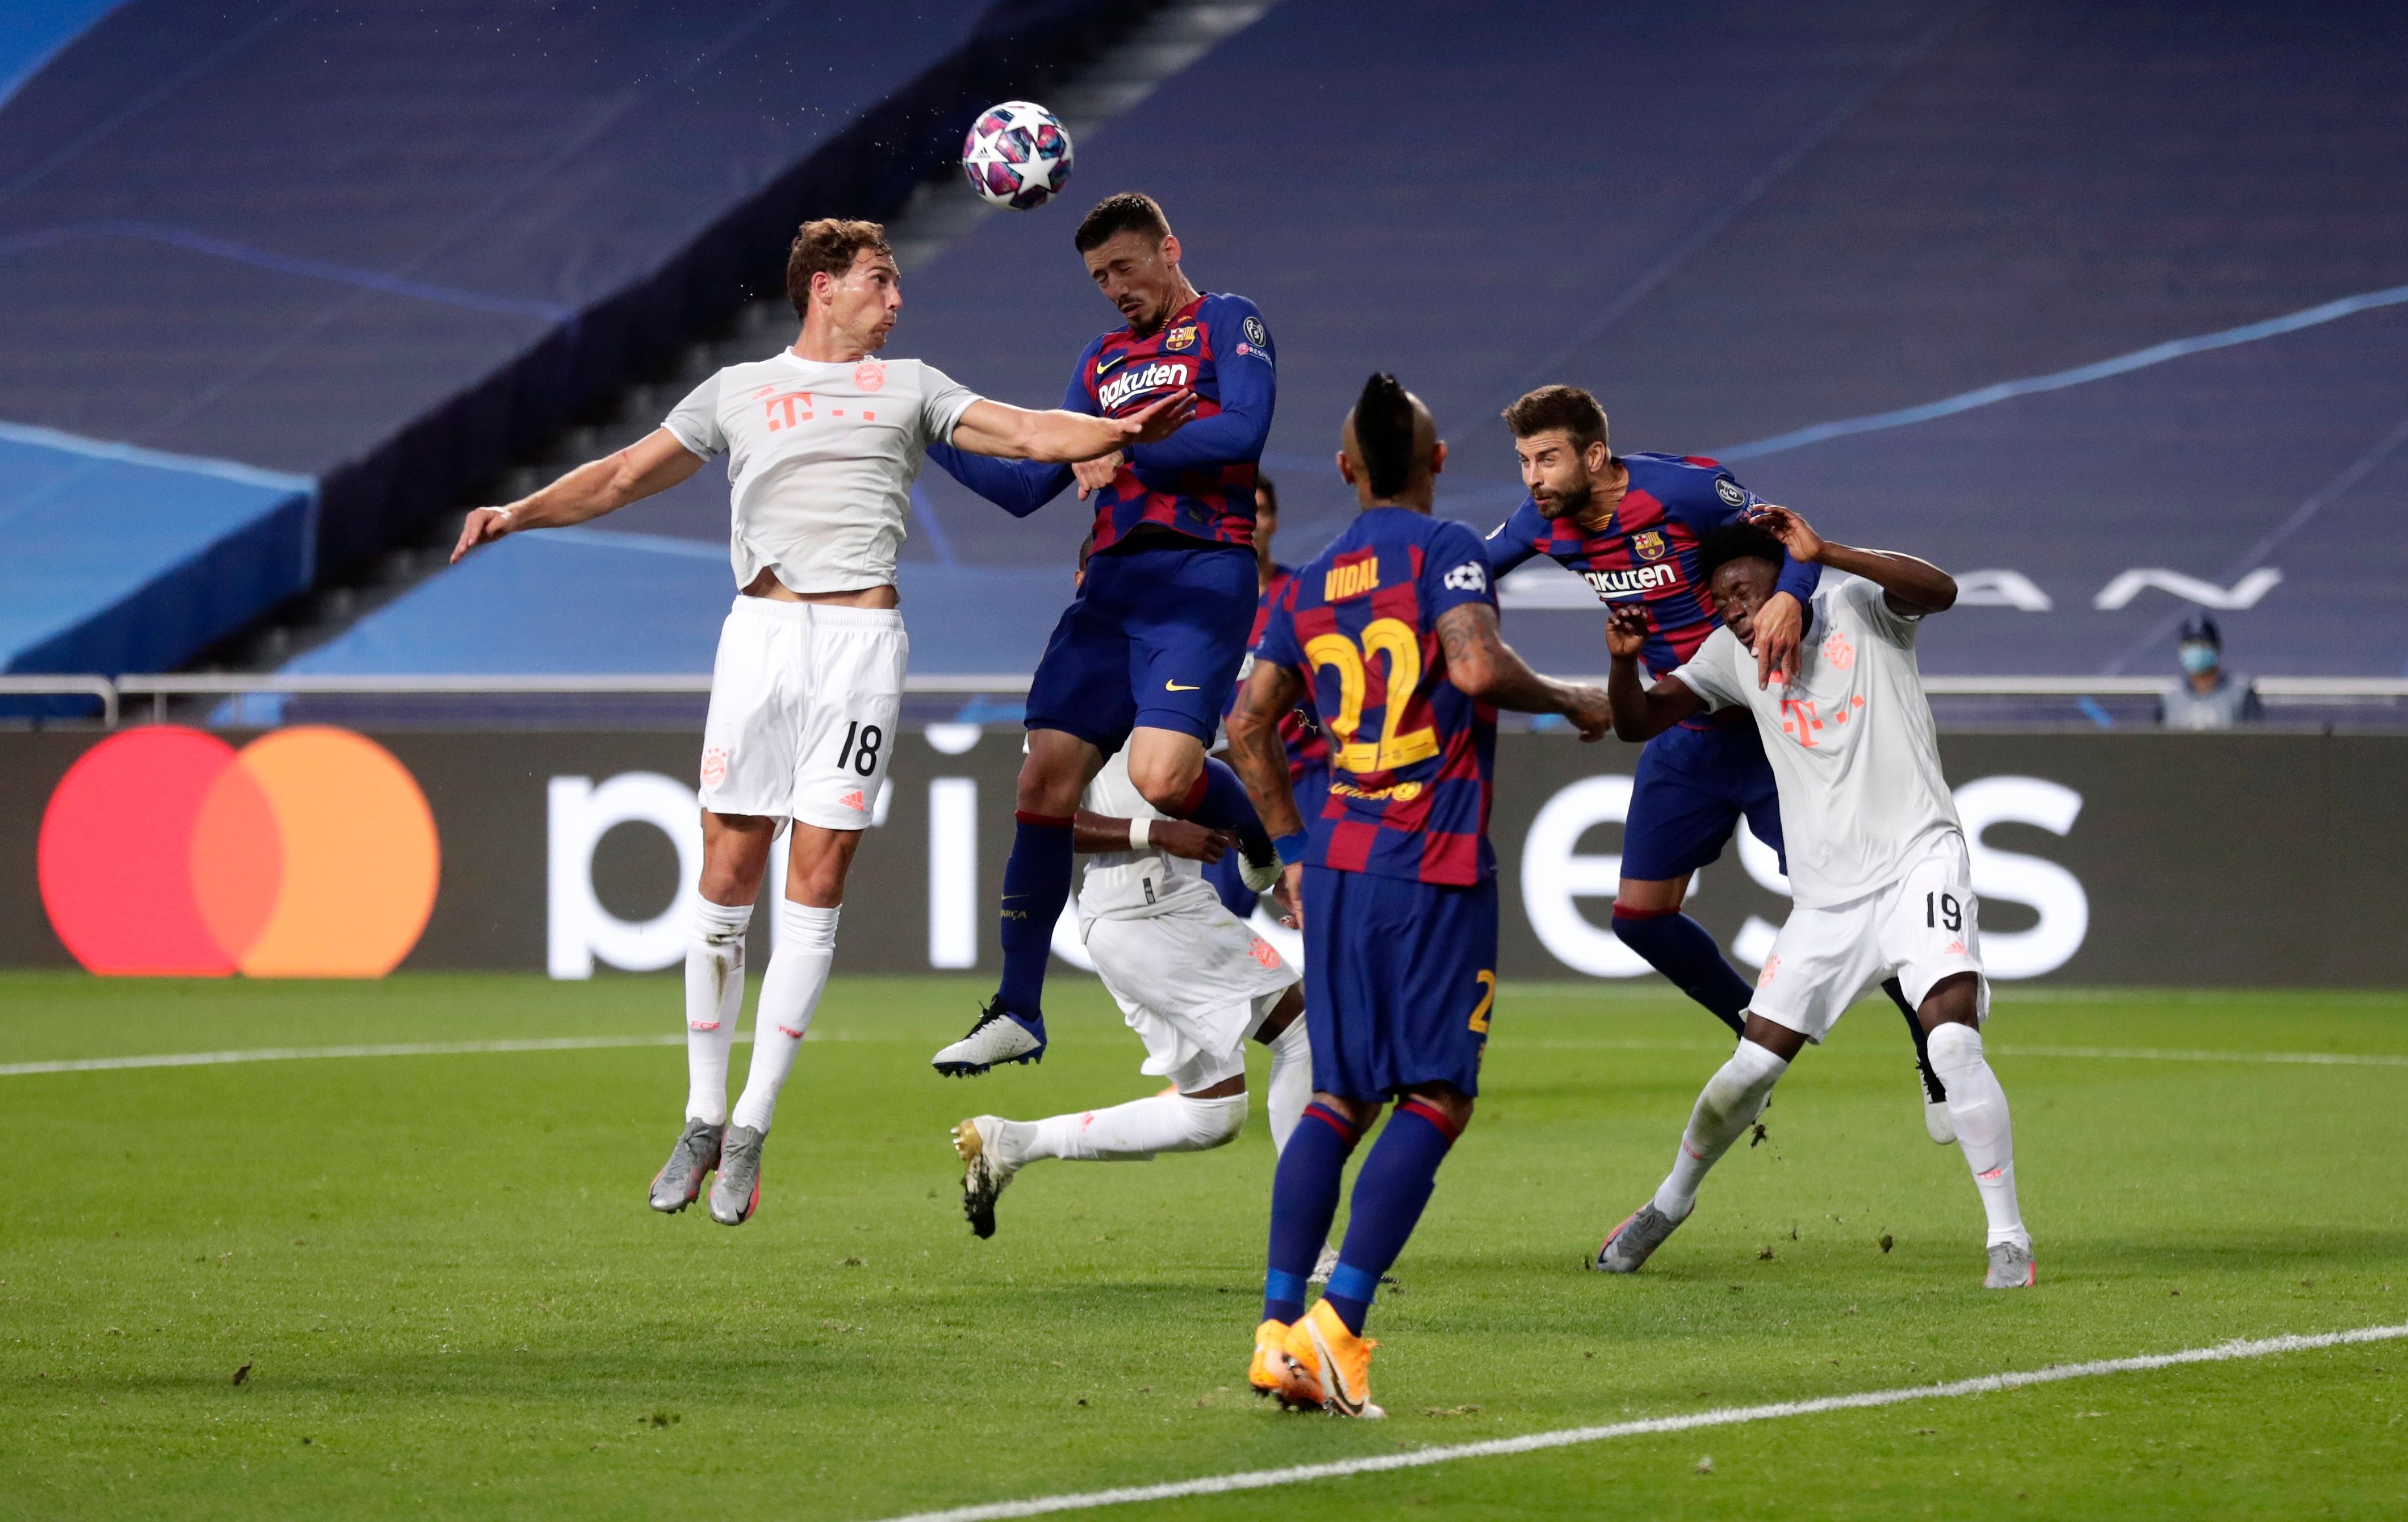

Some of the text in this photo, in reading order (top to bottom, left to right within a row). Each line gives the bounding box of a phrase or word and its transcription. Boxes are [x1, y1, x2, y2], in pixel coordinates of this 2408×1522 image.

[1098, 363, 1188, 411] Rakuten
[1324, 557, 1379, 602] VIDAL
[1584, 564, 1676, 591] akuten
[1304, 617, 1441, 773] 22
[837, 721, 882, 777] 18
[1000, 909, 1027, 921] ARÇA
[1926, 891, 1962, 932] 19
[1468, 969, 1496, 1034] 2
